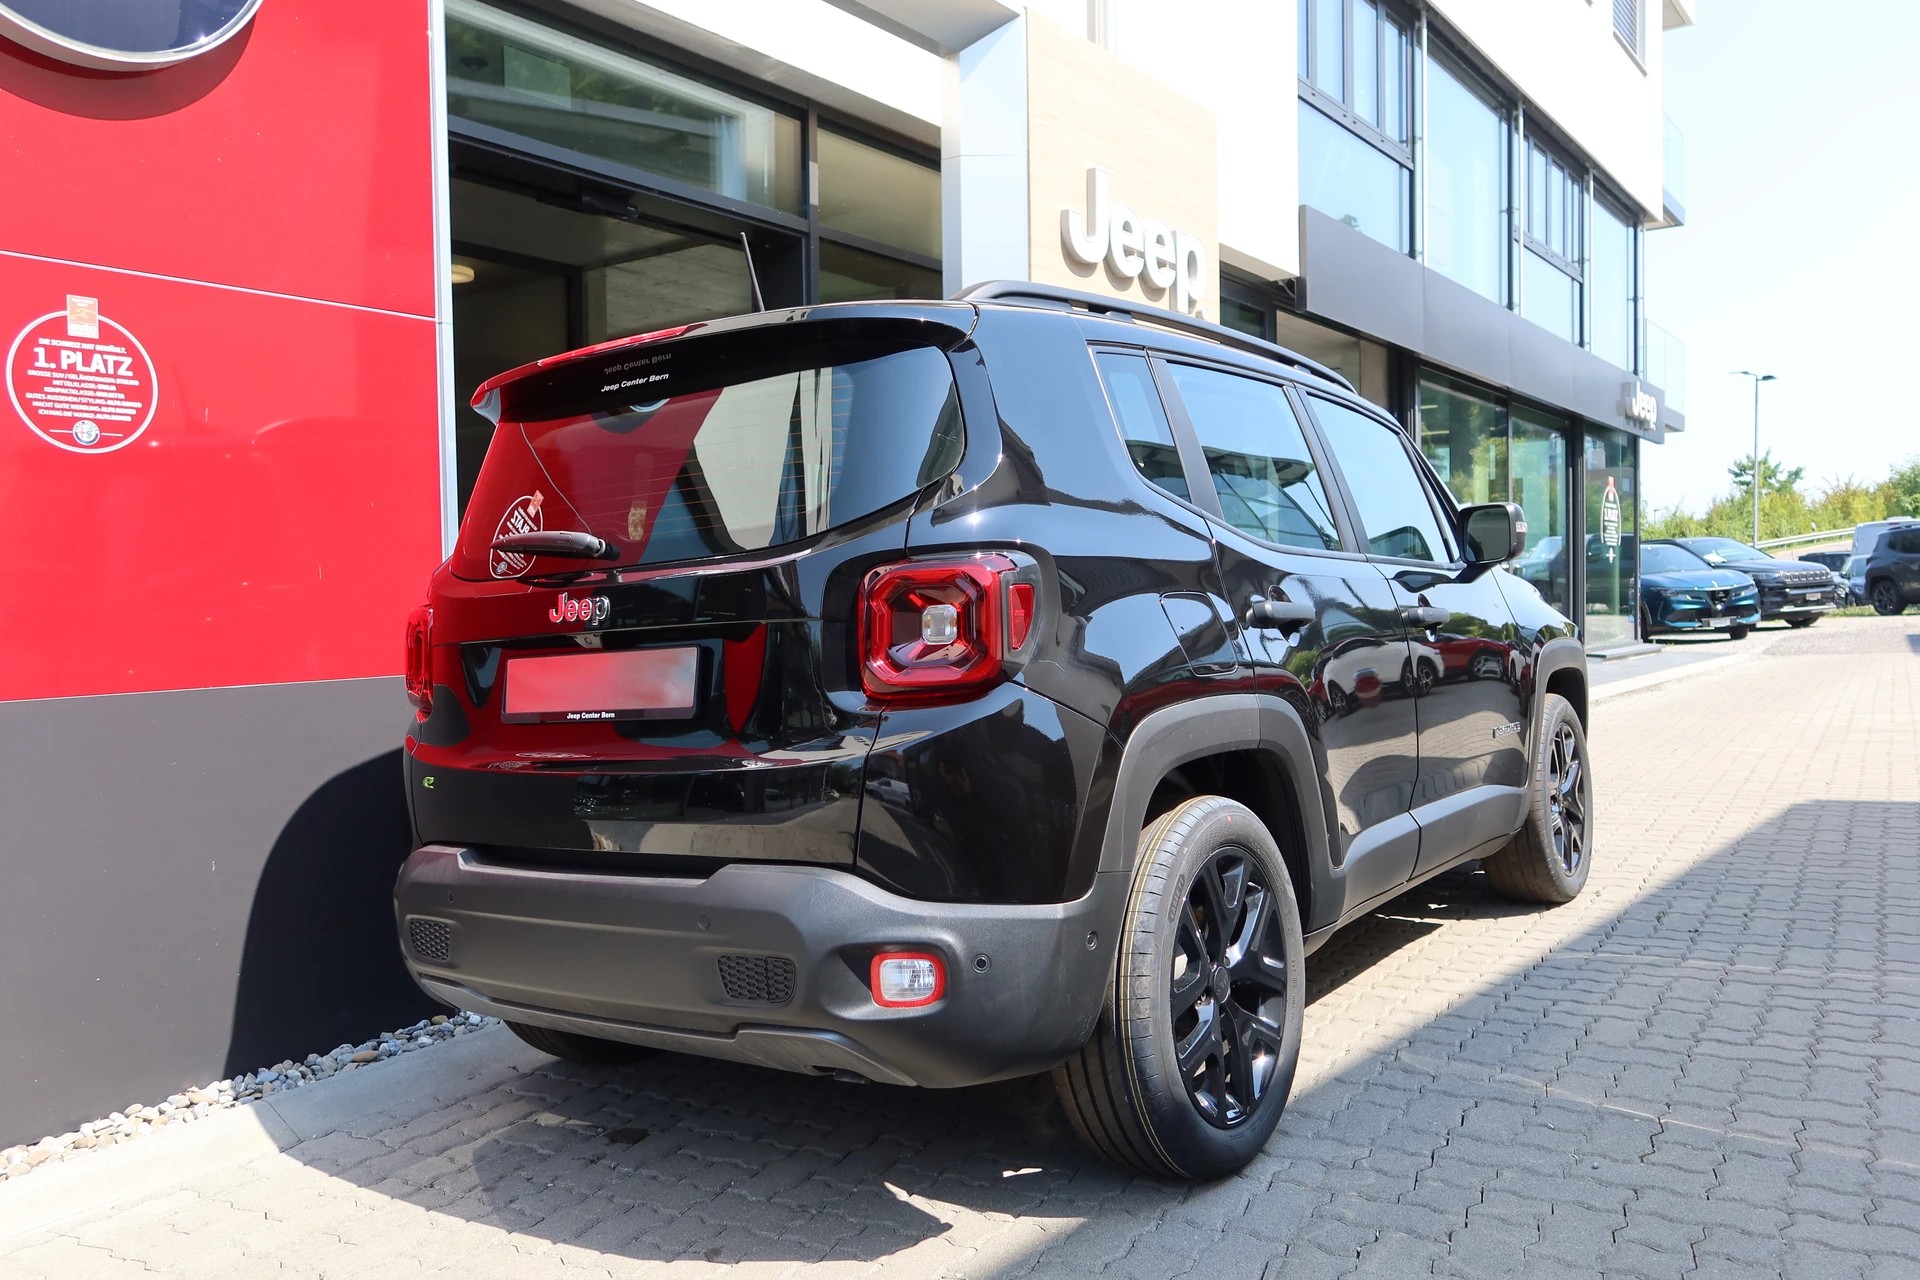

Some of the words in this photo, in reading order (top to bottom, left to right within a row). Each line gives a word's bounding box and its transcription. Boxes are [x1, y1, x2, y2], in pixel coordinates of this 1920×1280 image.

[1060, 168, 1207, 314] Jeep
[33, 346, 57, 369] 1.
[61, 350, 133, 376] PLATZ
[601, 383, 620, 392] Jeep
[621, 377, 648, 388] Center
[649, 373, 669, 382] Bern
[1631, 380, 1657, 430] Jeep
[549, 592, 611, 626] Jeep
[567, 712, 581, 720] Jeep
[601, 711, 615, 719] Bern
